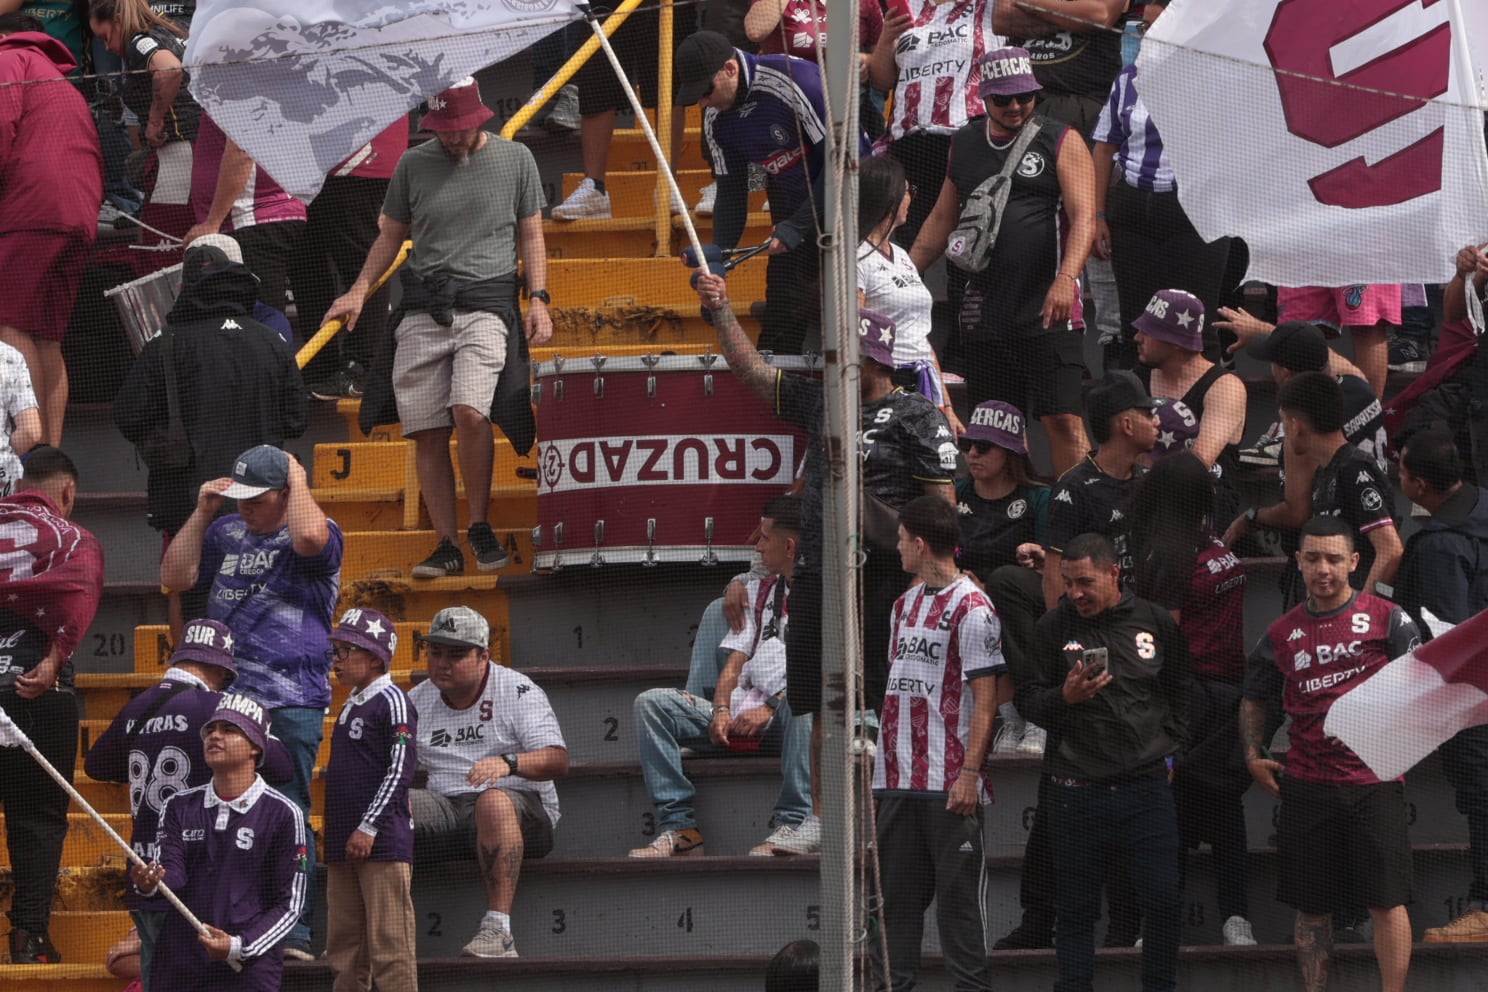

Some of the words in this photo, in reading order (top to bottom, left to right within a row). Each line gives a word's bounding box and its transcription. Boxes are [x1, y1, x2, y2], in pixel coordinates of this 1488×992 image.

[899, 60, 966, 84] LIBERTY
[1350, 612, 1371, 634] S
[93, 632, 125, 657] 20
[185, 624, 216, 648] SUR
[909, 635, 941, 660] BAC
[1315, 640, 1364, 666] BAC
[1299, 665, 1366, 694] LIBERTY
[454, 724, 485, 744] BAC
[603, 716, 619, 741] 2
[128, 746, 190, 814] 88
[428, 912, 442, 937] 2
[551, 909, 567, 935] 3
[676, 906, 694, 934] 4
